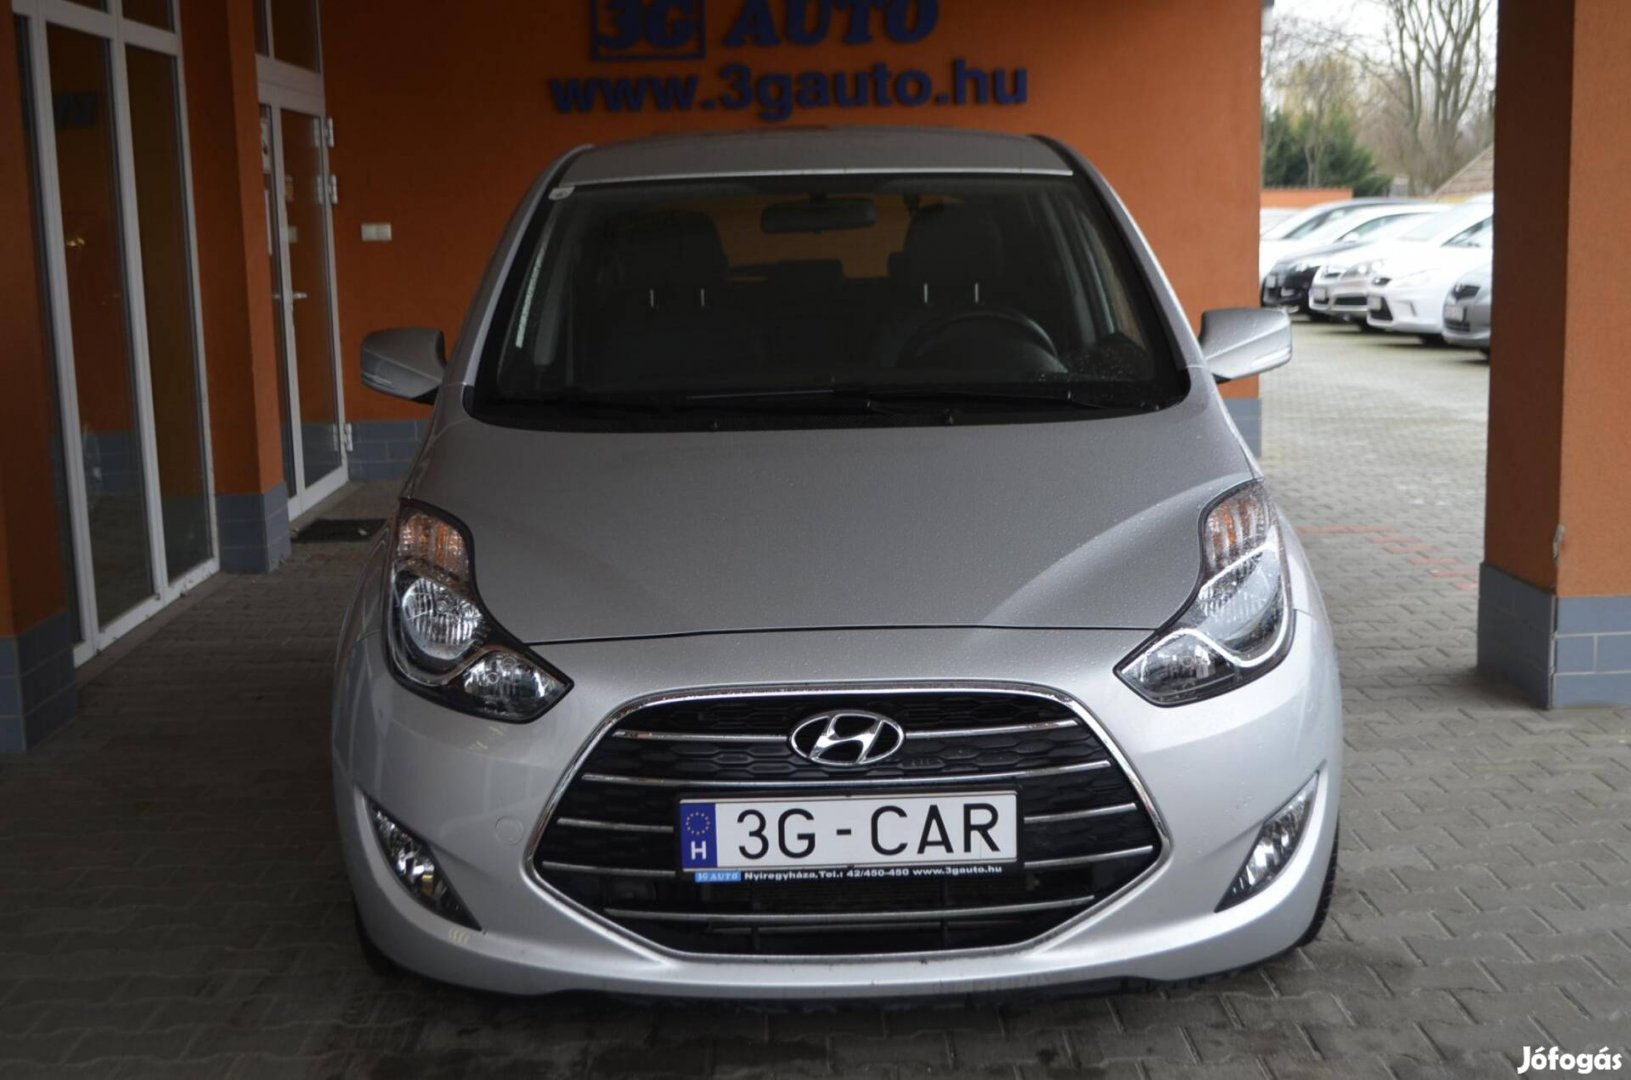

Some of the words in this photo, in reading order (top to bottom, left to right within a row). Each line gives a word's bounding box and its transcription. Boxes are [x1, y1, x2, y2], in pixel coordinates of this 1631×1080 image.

[597, 0, 697, 48] 3G
[723, 0, 939, 46] AUTO
[550, 59, 1027, 120] www.3gauto.hu
[691, 841, 707, 860] H
[737, 808, 816, 859] 3G
[871, 803, 1000, 855] CAR
[912, 865, 1003, 876] www.3gauto.hu
